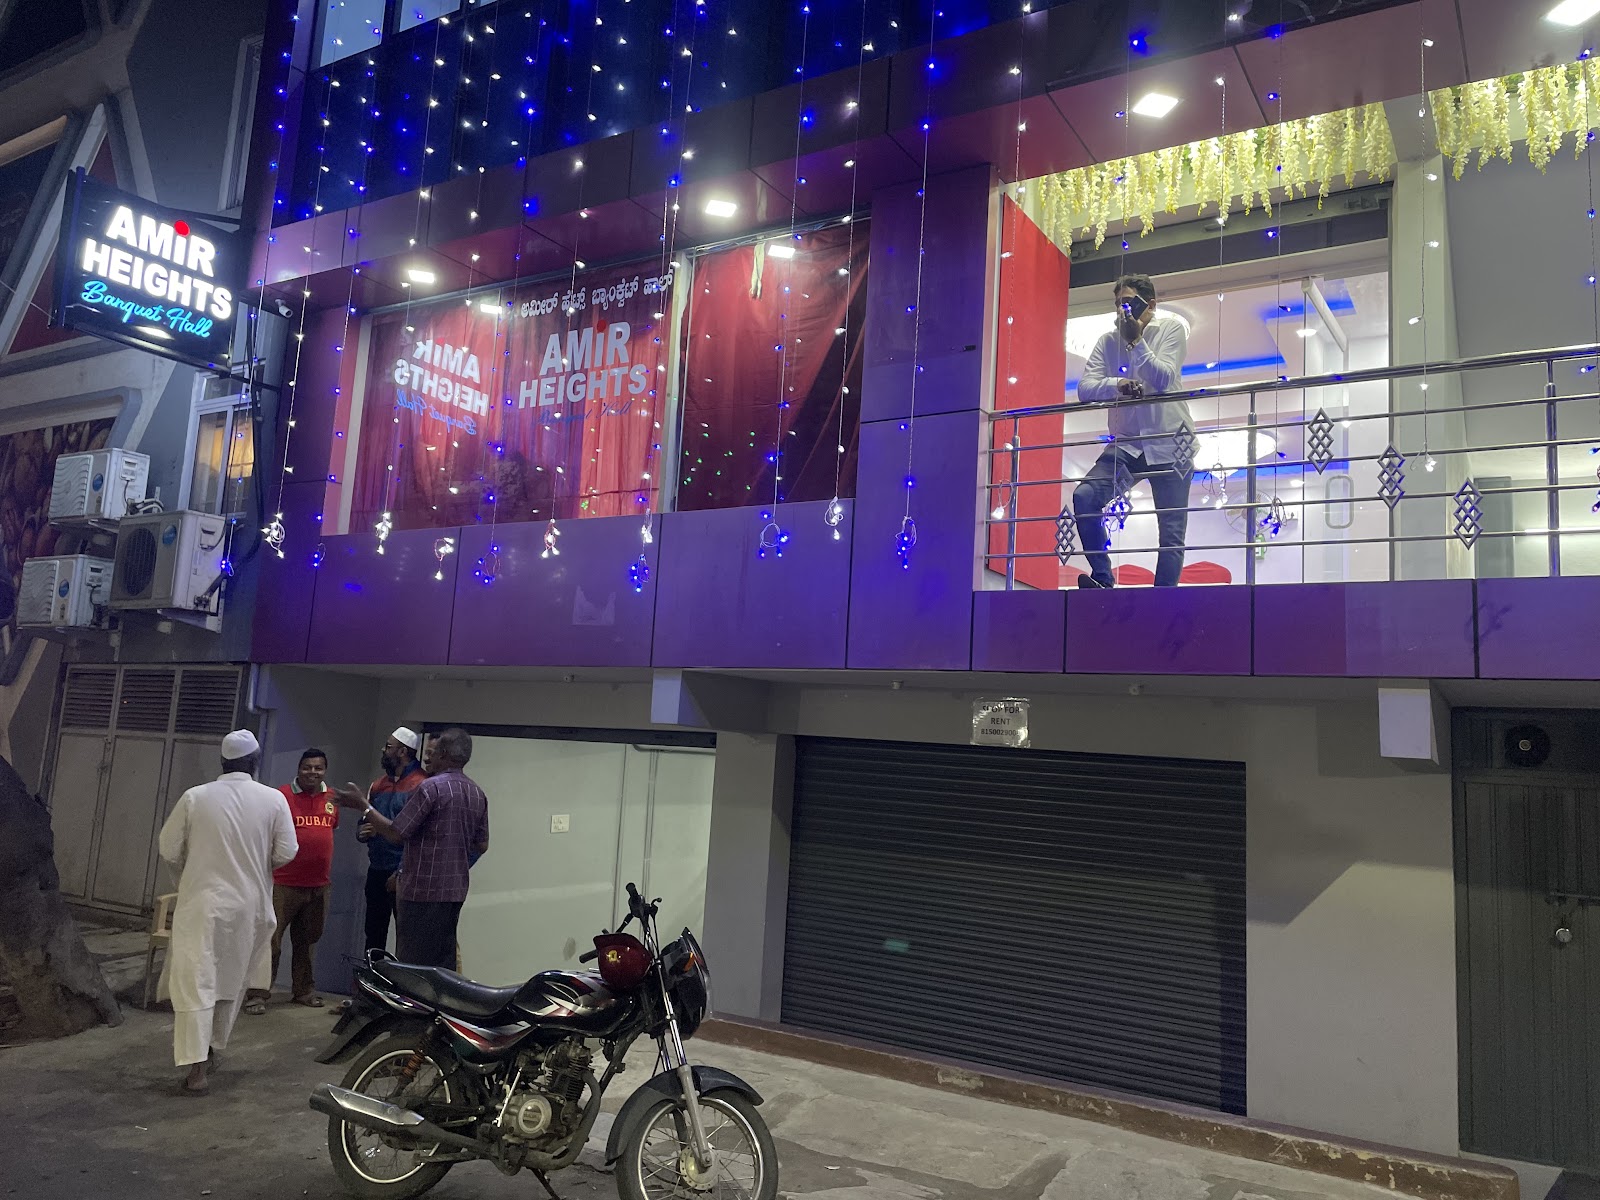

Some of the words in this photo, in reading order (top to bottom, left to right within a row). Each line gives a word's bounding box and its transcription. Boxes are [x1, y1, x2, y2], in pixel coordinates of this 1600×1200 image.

[82, 237, 233, 320] HEIGHTS
[81, 280, 165, 323] Banquet
[166, 307, 213, 338] Hall
[518, 363, 647, 409] HEIGHTS
[990, 717, 1011, 725] RENT
[1004, 706, 1020, 714] FOR
